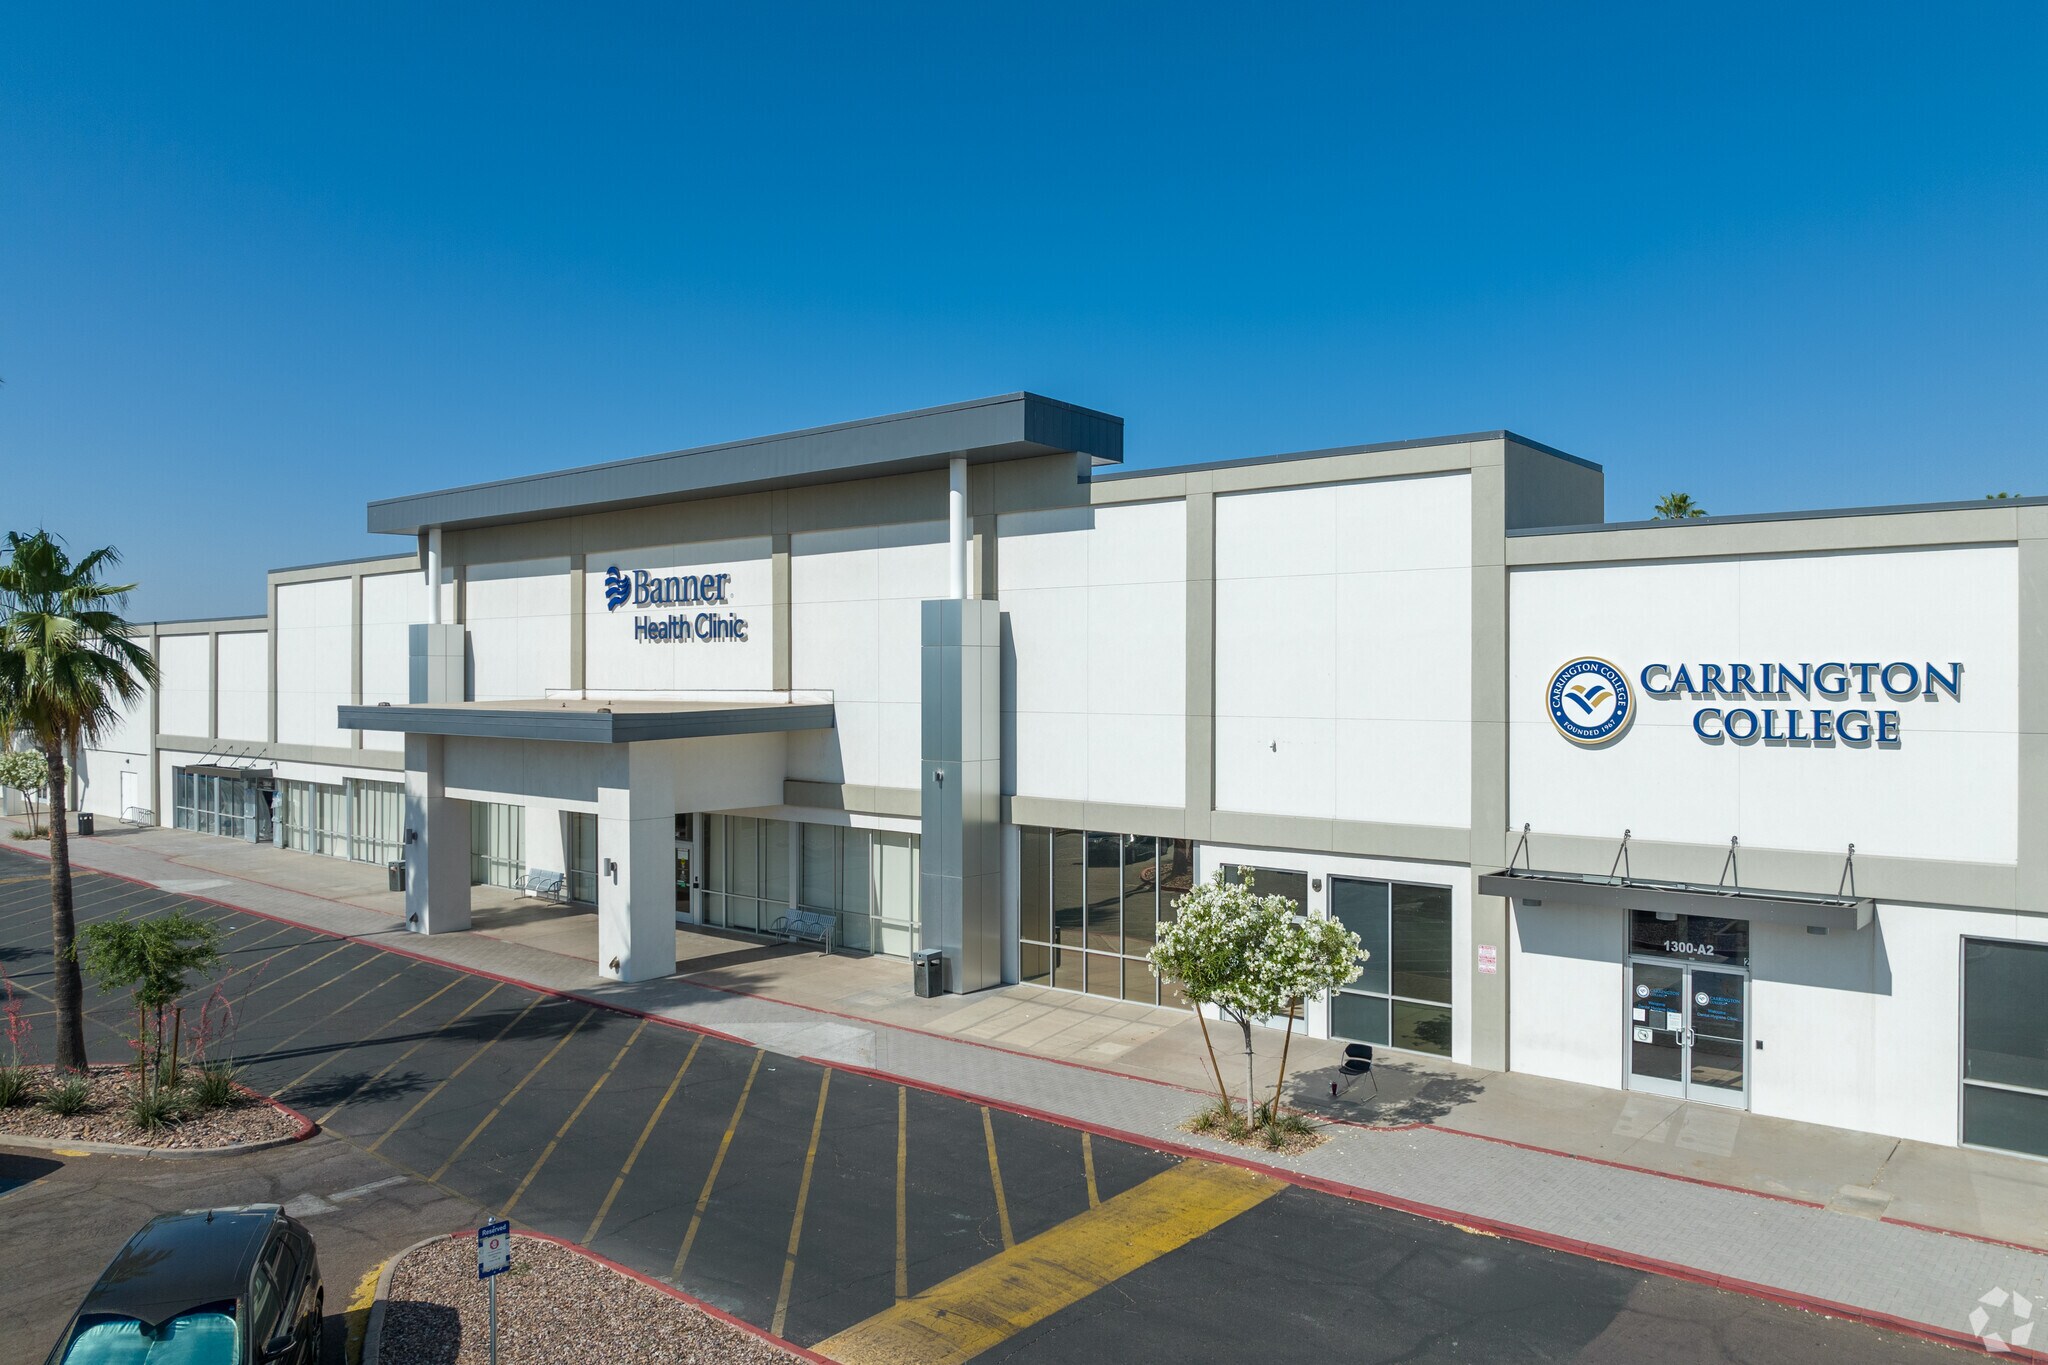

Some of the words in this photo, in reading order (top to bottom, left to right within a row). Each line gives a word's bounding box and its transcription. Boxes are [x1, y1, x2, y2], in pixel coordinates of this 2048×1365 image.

[632, 569, 728, 605] Banner
[634, 613, 691, 640] Health
[695, 612, 745, 639] Clinic
[1552, 663, 1599, 708] CARRINGTON
[1600, 666, 1627, 706] COLLEGE
[1640, 661, 1963, 697] CARRINGTON
[1563, 721, 1600, 736] FOUNDED
[1601, 719, 1616, 733] 1967
[1692, 707, 1900, 743] COLLEGE
[1663, 940, 1715, 956] 1300-A2
[1710, 996, 1742, 1004] CARRINGTON
[481, 1224, 507, 1236] Reserved
